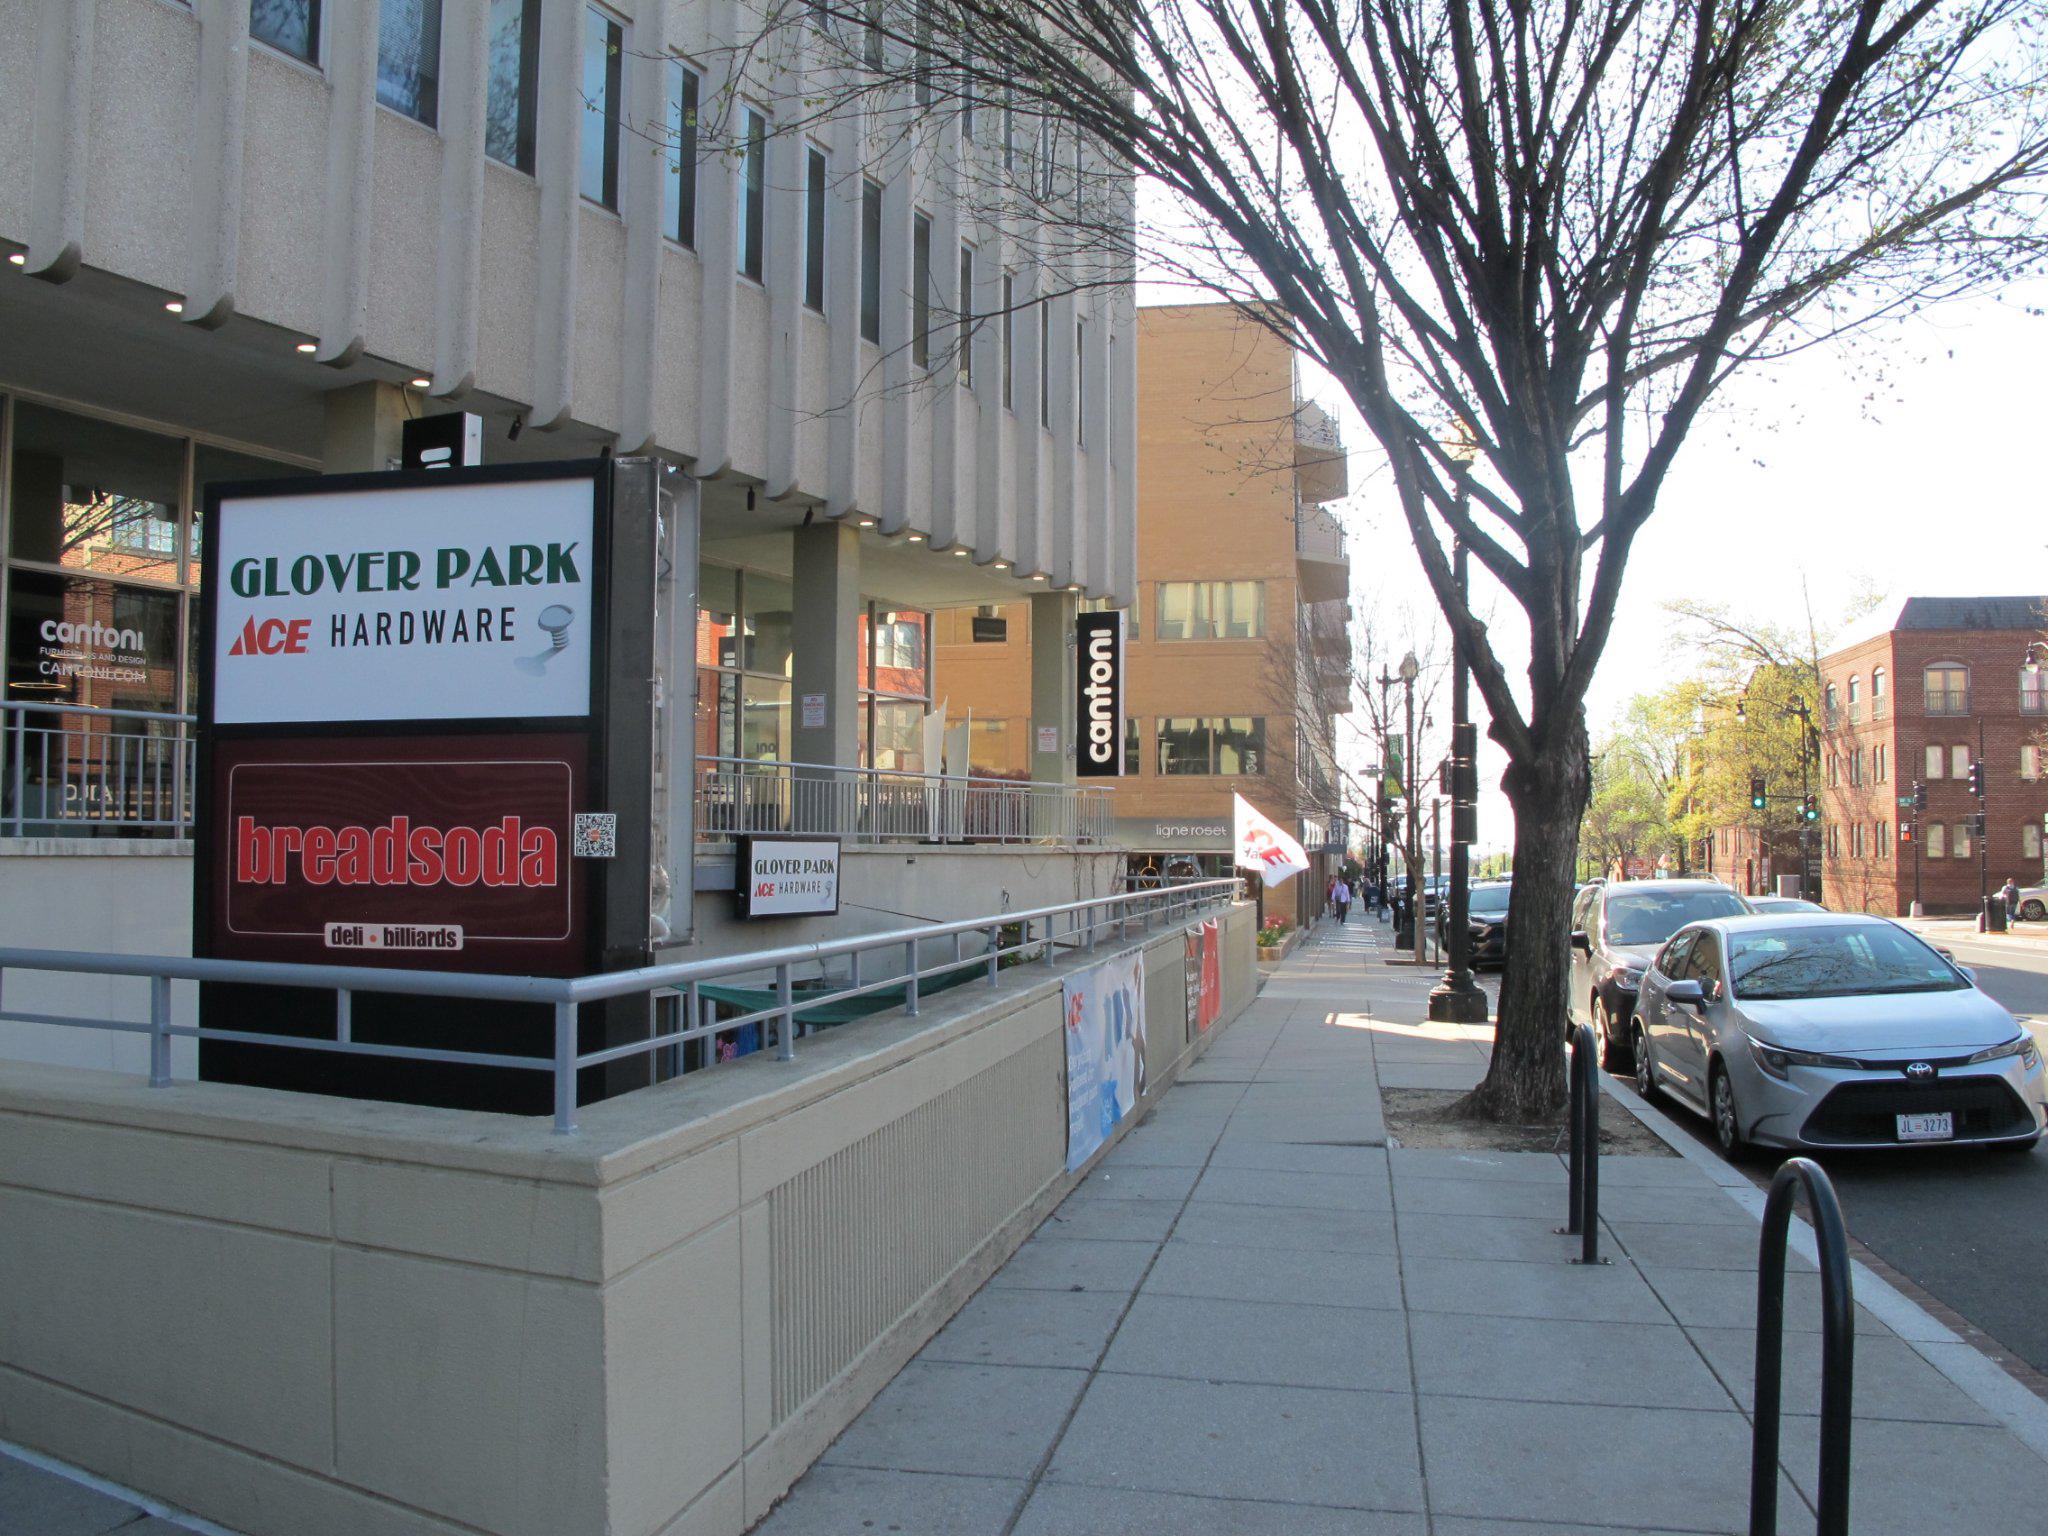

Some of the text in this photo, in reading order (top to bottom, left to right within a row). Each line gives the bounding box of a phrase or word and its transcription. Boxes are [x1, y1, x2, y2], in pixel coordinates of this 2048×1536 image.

[230, 542, 581, 598] GLOVER PARK
[41, 620, 144, 651] cantoni
[228, 606, 516, 656] ACE HARDWARE
[99, 653, 117, 663] AND
[118, 654, 146, 665] DESIGN
[1083, 629, 1113, 763] cantoni
[1155, 824, 1228, 839] ligne roset
[237, 815, 558, 888] breadsoda
[755, 858, 835, 875] GLOVER PARK
[754, 881, 821, 897] ACE HARDWARE
[331, 926, 457, 949] deli billiards
[1923, 1118, 1949, 1132] 3273
